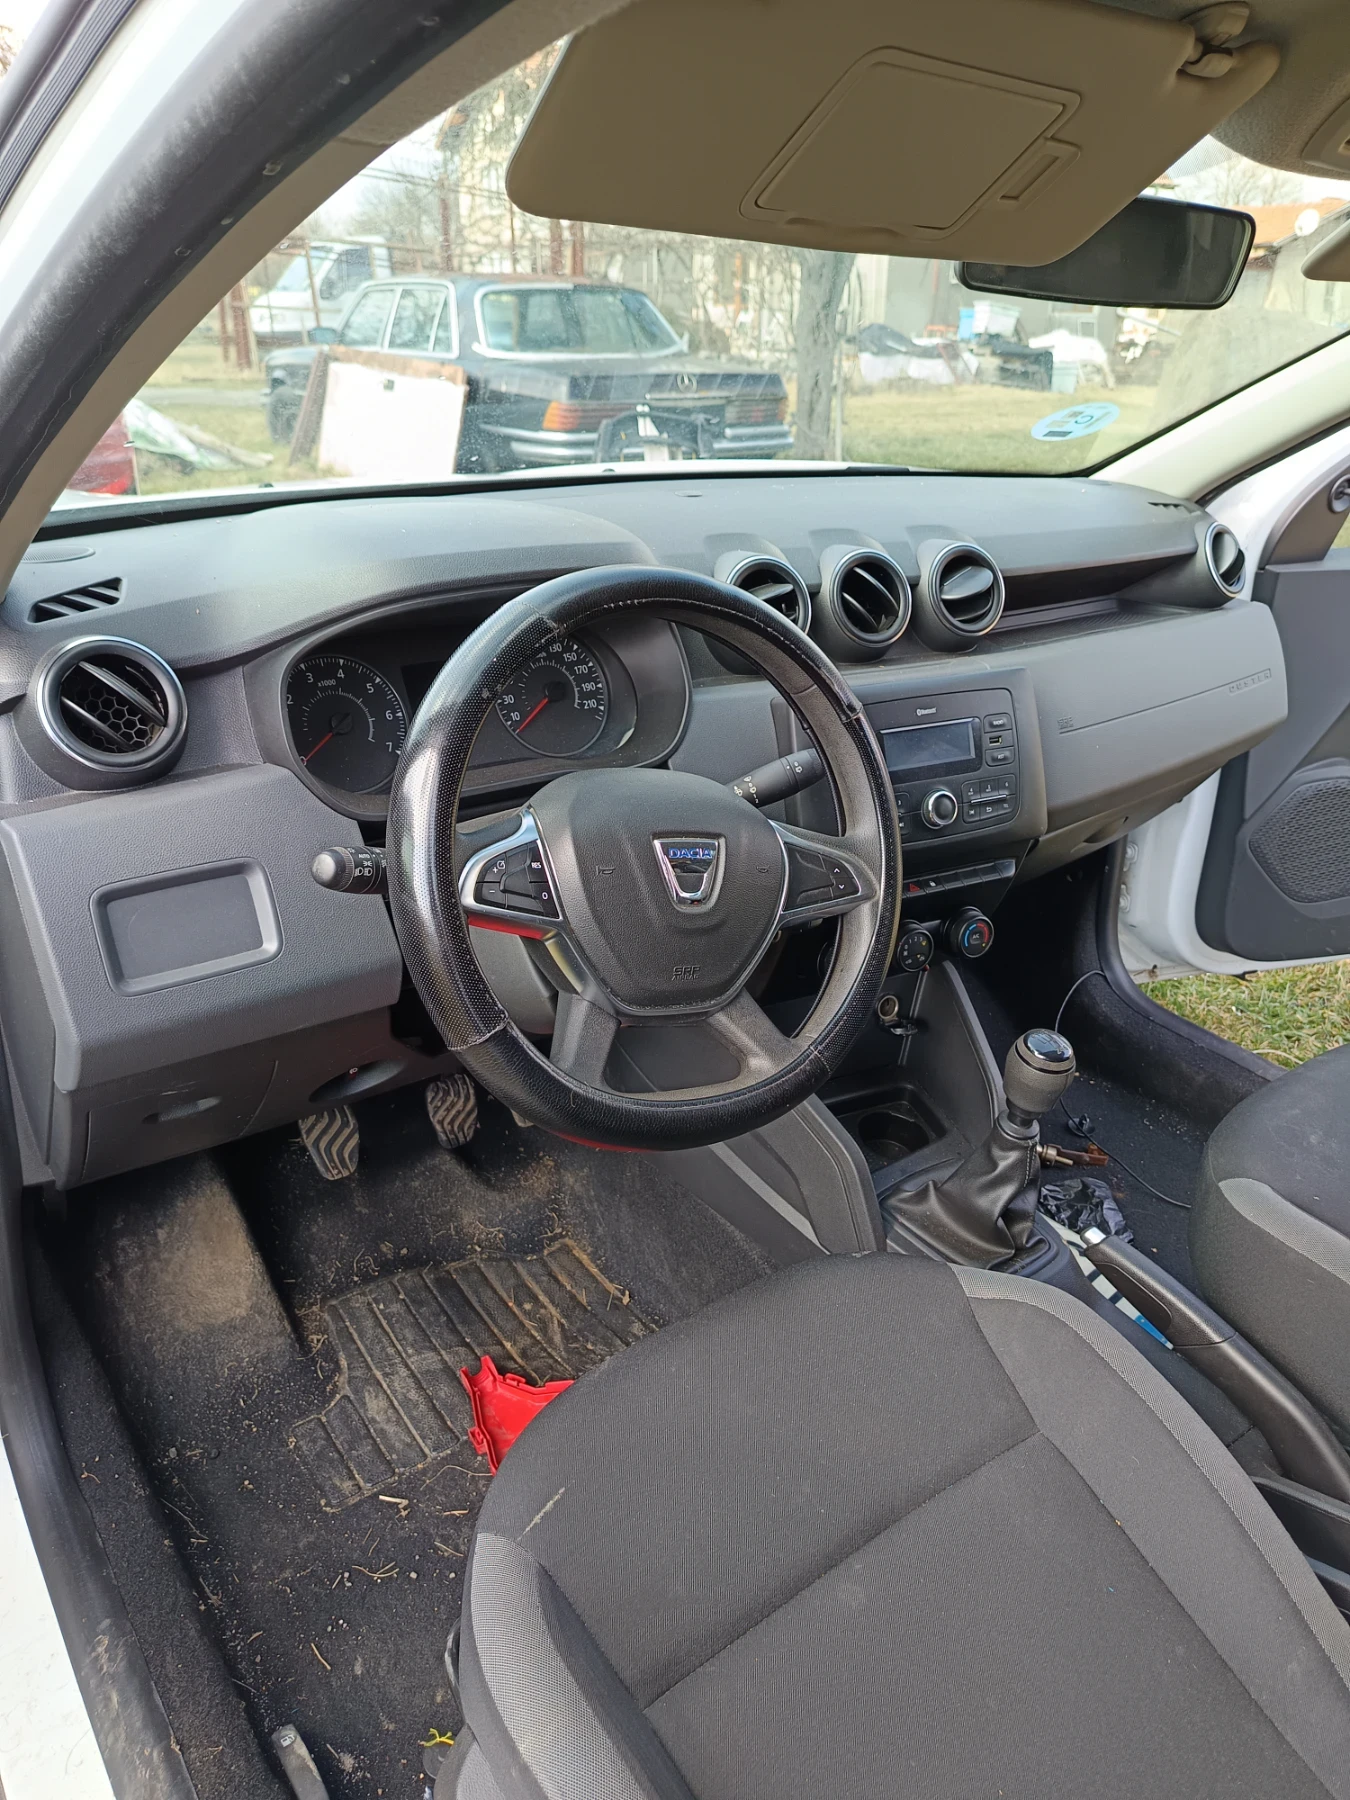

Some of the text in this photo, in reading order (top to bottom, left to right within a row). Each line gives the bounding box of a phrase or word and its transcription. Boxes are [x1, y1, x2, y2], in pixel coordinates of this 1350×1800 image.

[563, 652, 578, 662] 150
[337, 669, 345, 679] 4
[574, 664, 589, 675] 170
[305, 672, 314, 683] 3
[317, 678, 337, 687] x1000
[366, 683, 374, 693] 5
[581, 681, 596, 692] 190
[287, 694, 294, 705] 2
[502, 694, 515, 705] 30
[582, 699, 597, 710] 210
[385, 710, 393, 720] 6
[510, 711, 520, 721] 10
[385, 741, 393, 752] 7
[669, 848, 712, 858] DACIA
